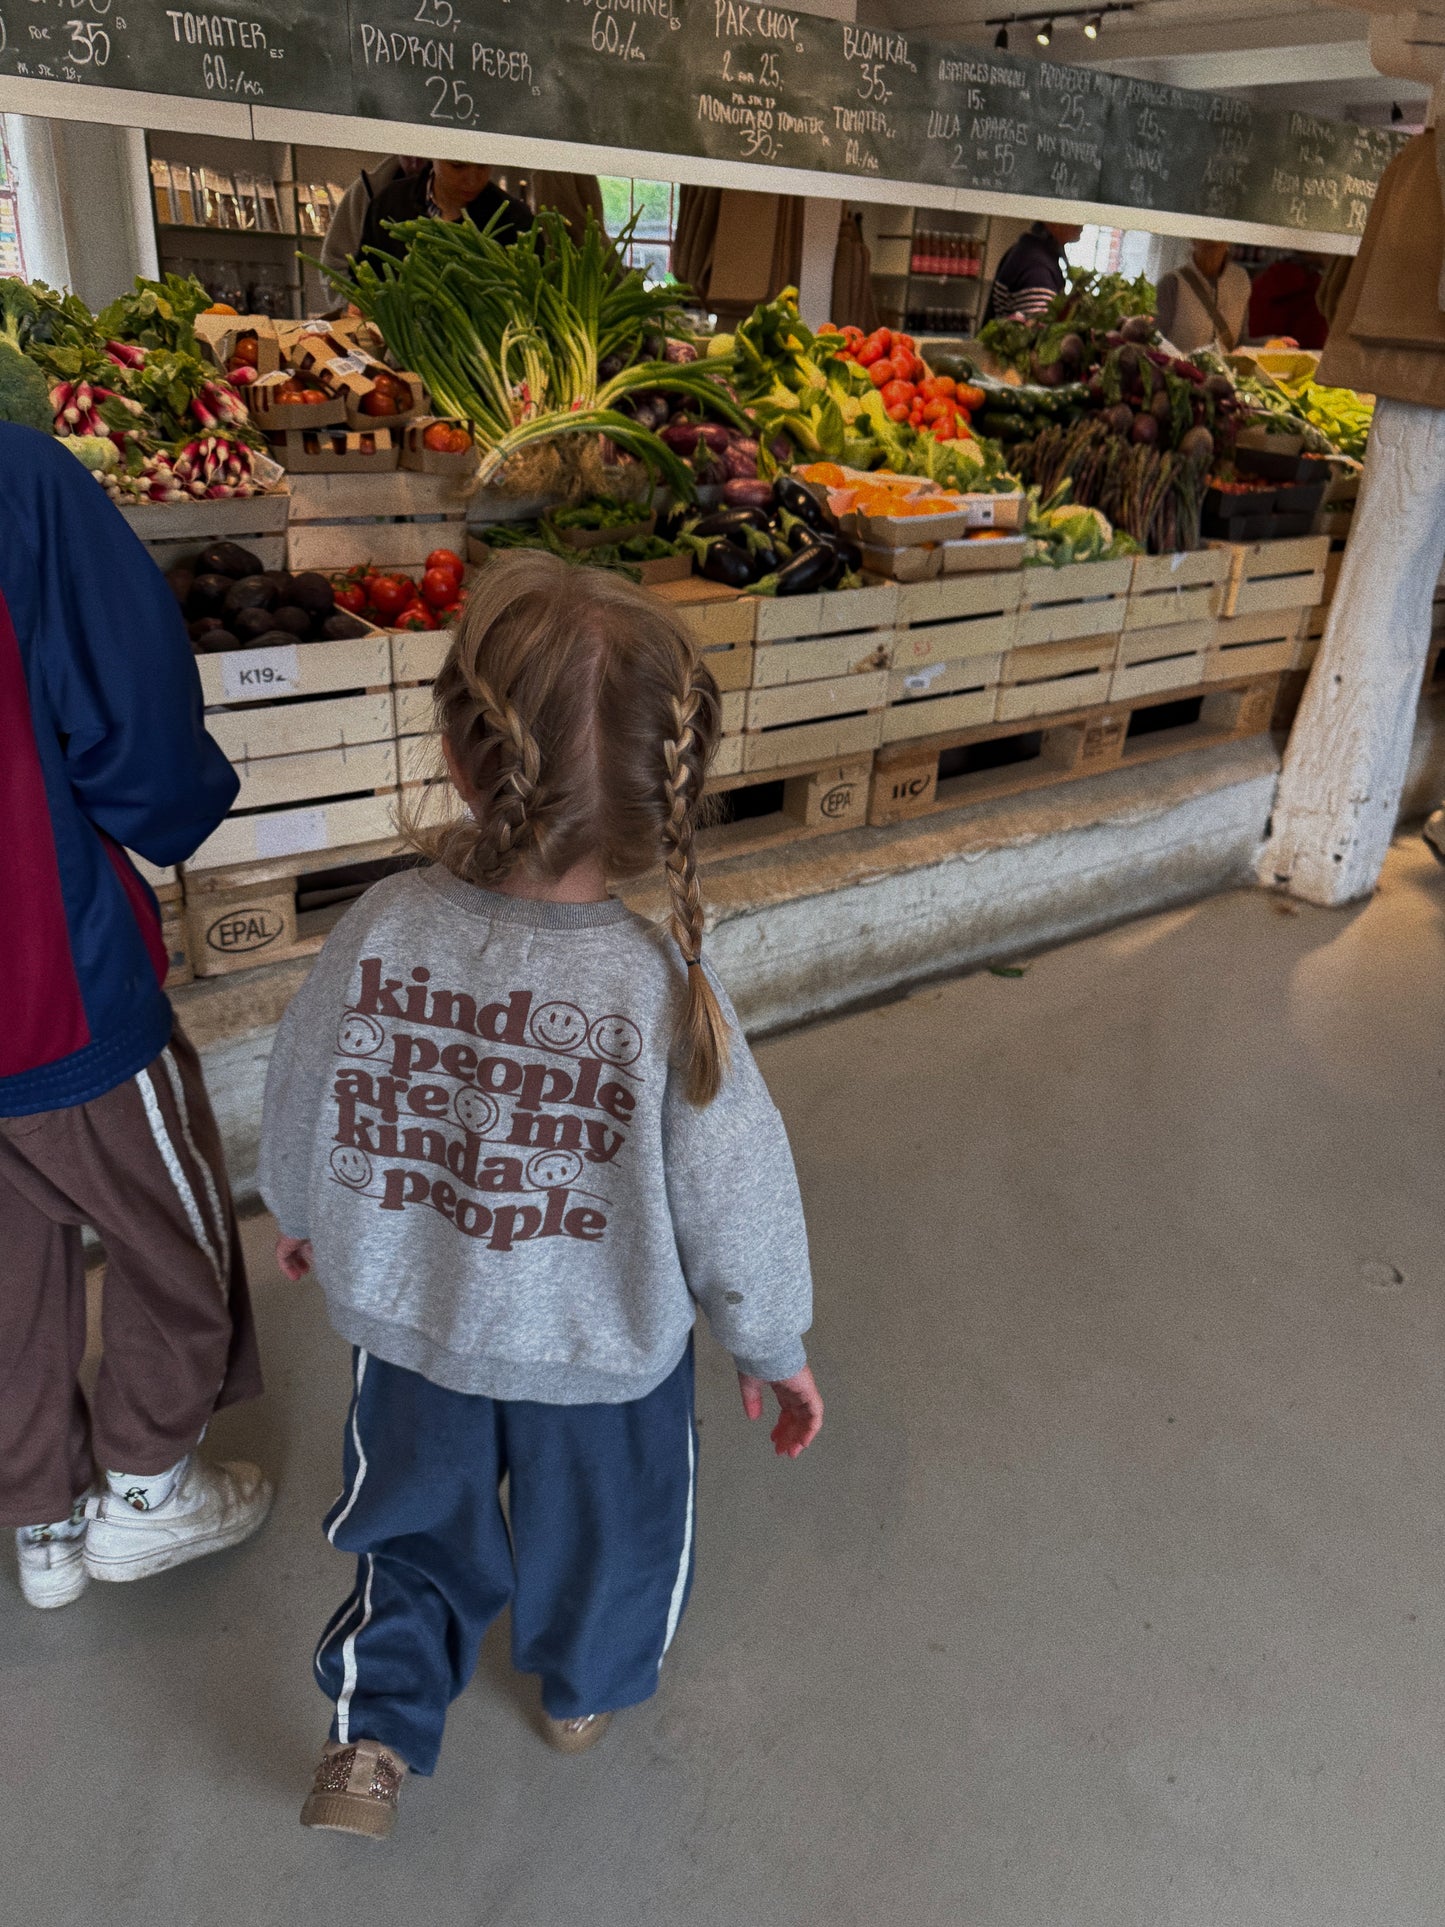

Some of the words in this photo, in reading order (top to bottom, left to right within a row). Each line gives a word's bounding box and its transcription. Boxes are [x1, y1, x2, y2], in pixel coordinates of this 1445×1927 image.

[66, 19, 111, 66] 35
[166, 9, 267, 49] TOMATER
[713, 0, 753, 38] PAK
[755, 8, 800, 42] CHOY
[360, 23, 454, 71] PADRON
[471, 42, 532, 86] PEBER
[832, 105, 887, 134] TOMATER
[219, 917, 272, 946] EPAL
[355, 957, 533, 1046] kind
[389, 1033, 636, 1122] people
[333, 1068, 450, 1123] are
[506, 1112, 625, 1163] my
[333, 1096, 524, 1193] kinda
[379, 1168, 608, 1252] people
